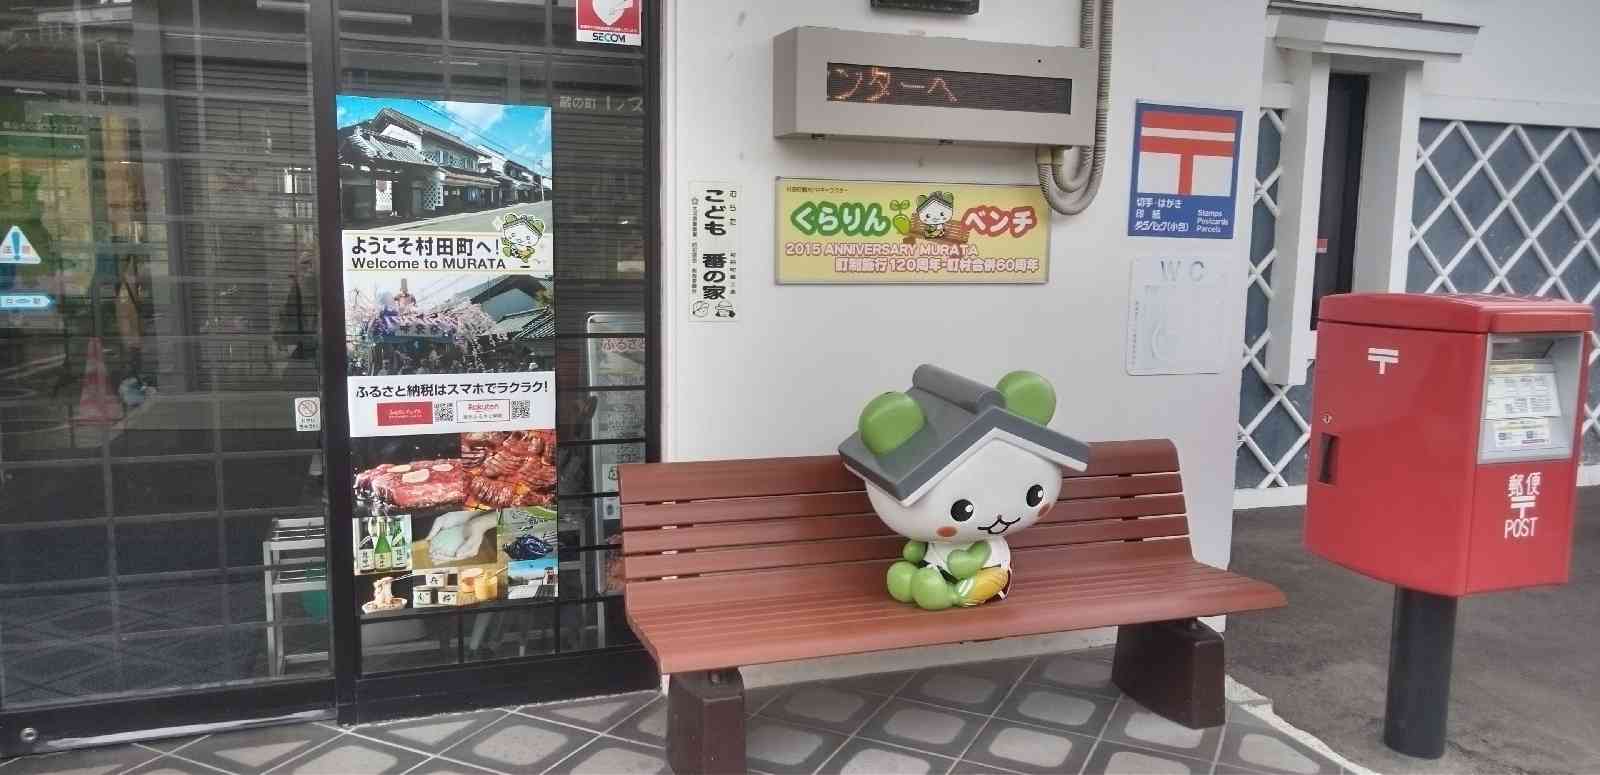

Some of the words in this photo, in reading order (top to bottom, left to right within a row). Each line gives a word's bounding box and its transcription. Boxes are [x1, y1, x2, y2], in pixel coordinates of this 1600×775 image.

[592, 32, 626, 43] SECOM
[834, 66, 960, 103] ンターへ
[704, 189, 727, 236] こども
[791, 201, 891, 236] くらりん
[960, 205, 1037, 238] ベンチ
[1197, 209, 1223, 217] Stamps
[1197, 217, 1229, 226] Postcards
[352, 236, 500, 256] ようこそ村田町へ!
[785, 242, 822, 257] 2015
[823, 242, 916, 257] ANNIVERSARY
[918, 243, 979, 257] MURATA
[352, 257, 419, 269] Welcome
[424, 258, 438, 269] to
[442, 258, 506, 269] MURATA
[702, 253, 728, 300] 番の家
[356, 381, 548, 398] ふるさと納税はスマホでラクラク!
[1507, 472, 1541, 497] 郵便
[1503, 516, 1539, 538] POST
